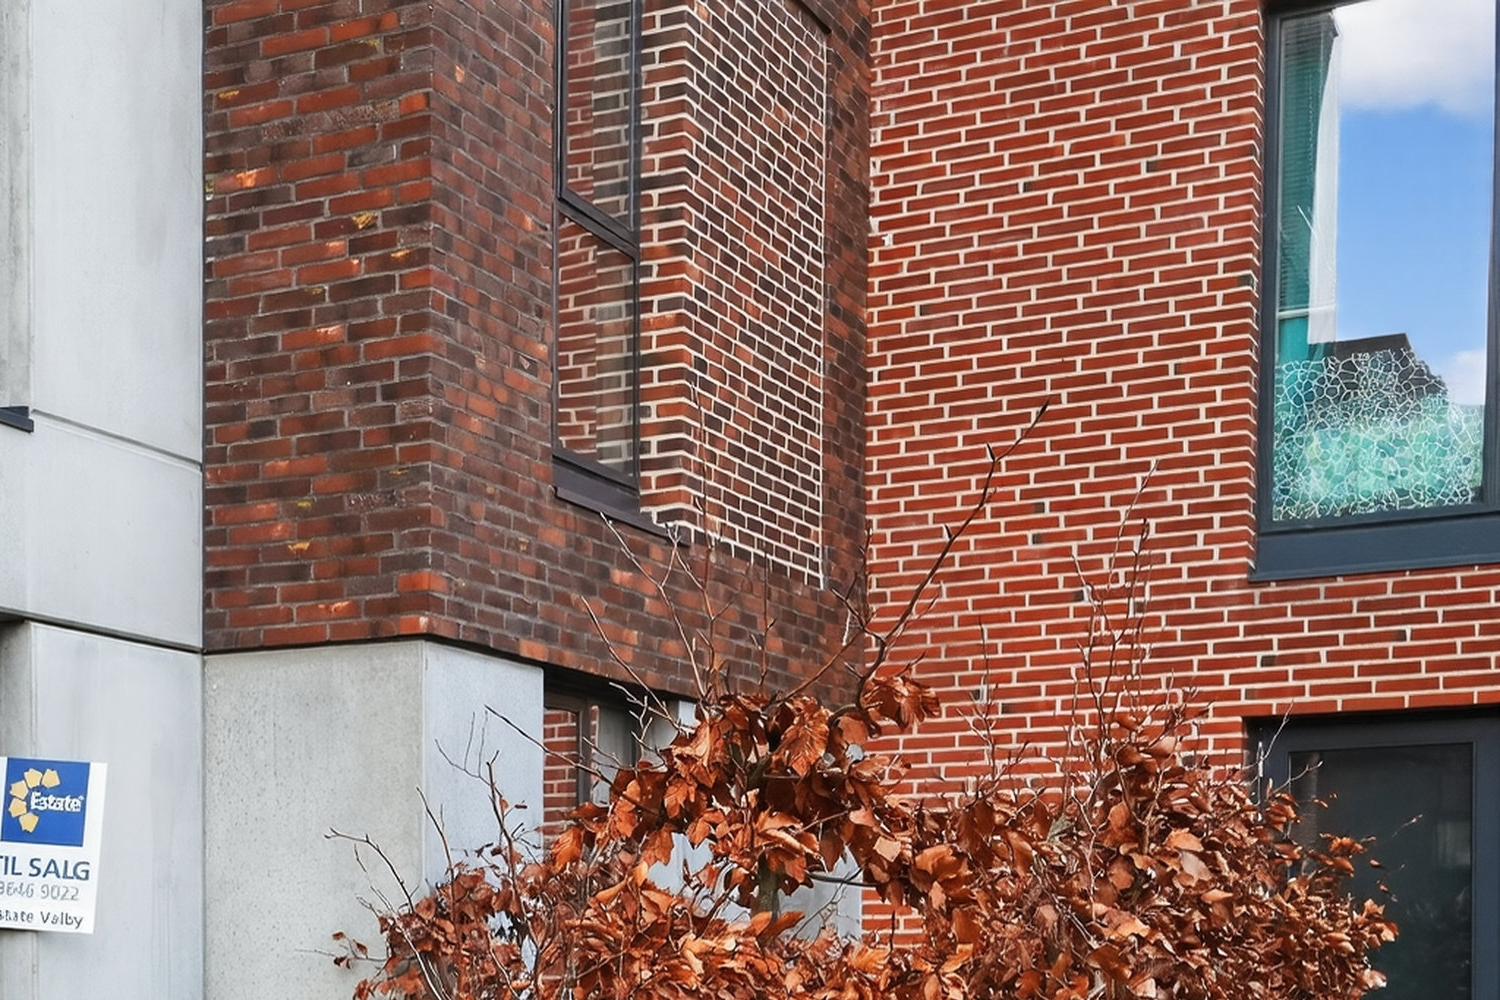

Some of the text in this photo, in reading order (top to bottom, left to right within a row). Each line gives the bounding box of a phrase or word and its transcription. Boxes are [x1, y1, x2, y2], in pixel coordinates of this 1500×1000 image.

[31, 791, 82, 812] Estate
[28, 858, 90, 881] SALG
[40, 883, 79, 901] 9022
[40, 911, 84, 929] Valby
